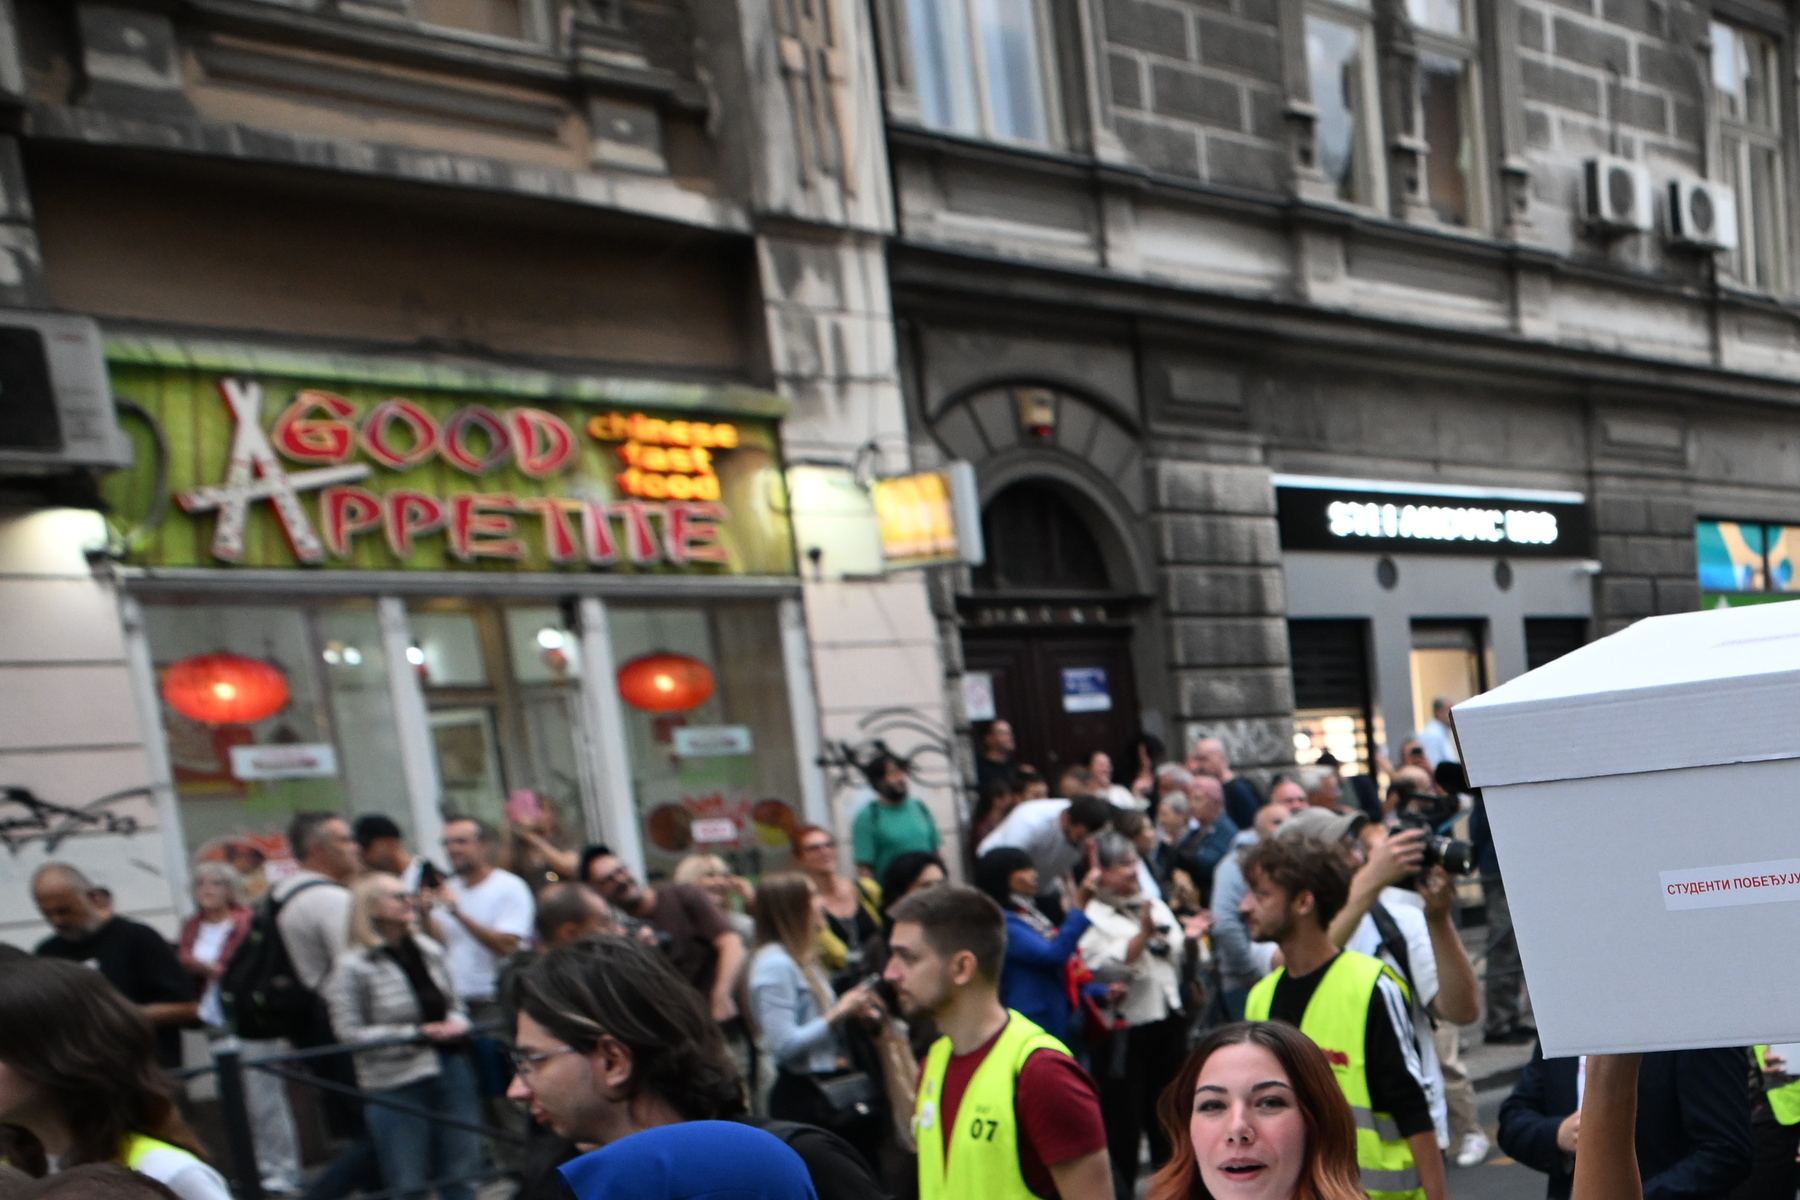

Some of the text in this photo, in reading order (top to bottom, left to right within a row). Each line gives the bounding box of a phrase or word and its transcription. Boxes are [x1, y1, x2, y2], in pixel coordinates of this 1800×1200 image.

[273, 389, 578, 479] GOOD
[174, 379, 728, 566] APPETITE
[1667, 879, 1731, 896] СТУДЕНТИ
[971, 1118, 998, 1142] 07
